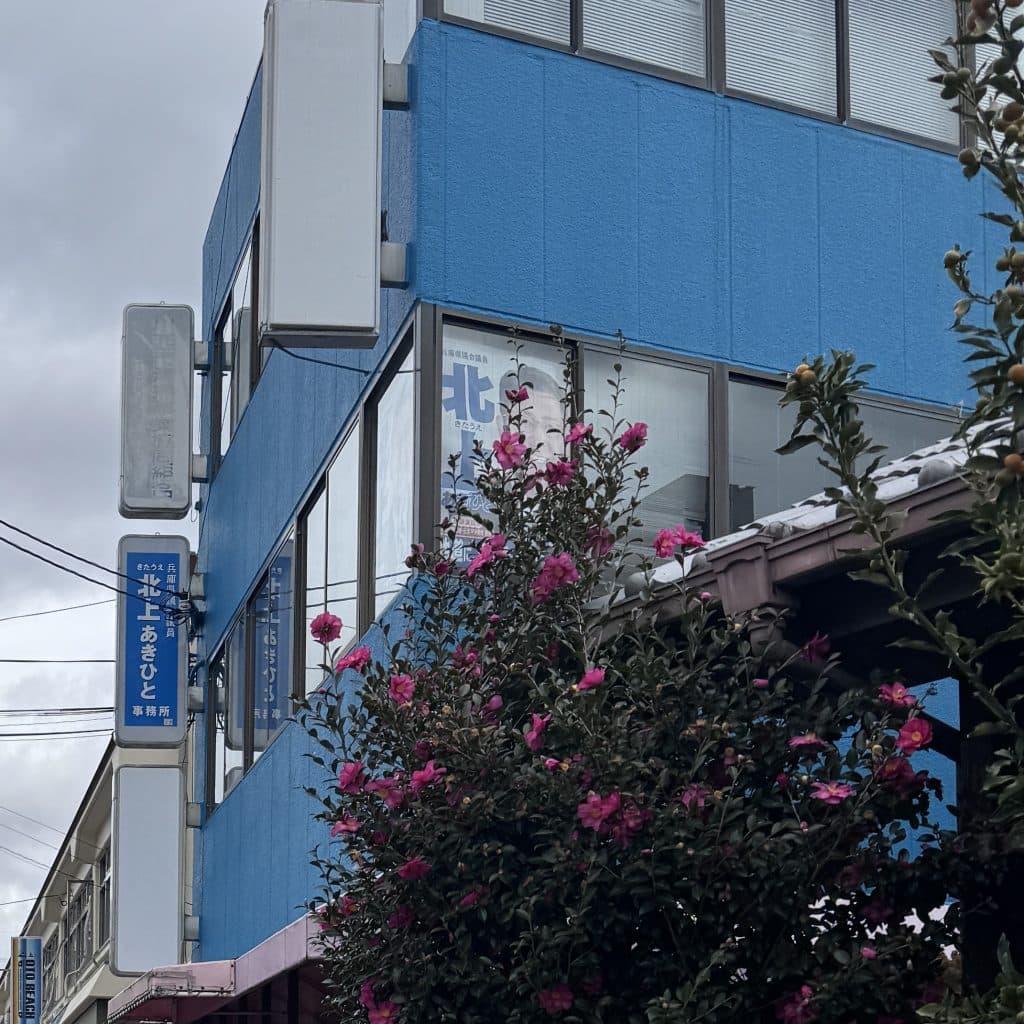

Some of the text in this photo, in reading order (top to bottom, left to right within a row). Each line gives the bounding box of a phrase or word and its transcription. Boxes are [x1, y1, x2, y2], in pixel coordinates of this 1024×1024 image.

[454, 420, 482, 432] きたうえ
[137, 563, 164, 571] きたうえ
[137, 573, 162, 700] 北上あきひと
[132, 705, 170, 717] 事務所
[25, 983, 36, 1019] BEACH
